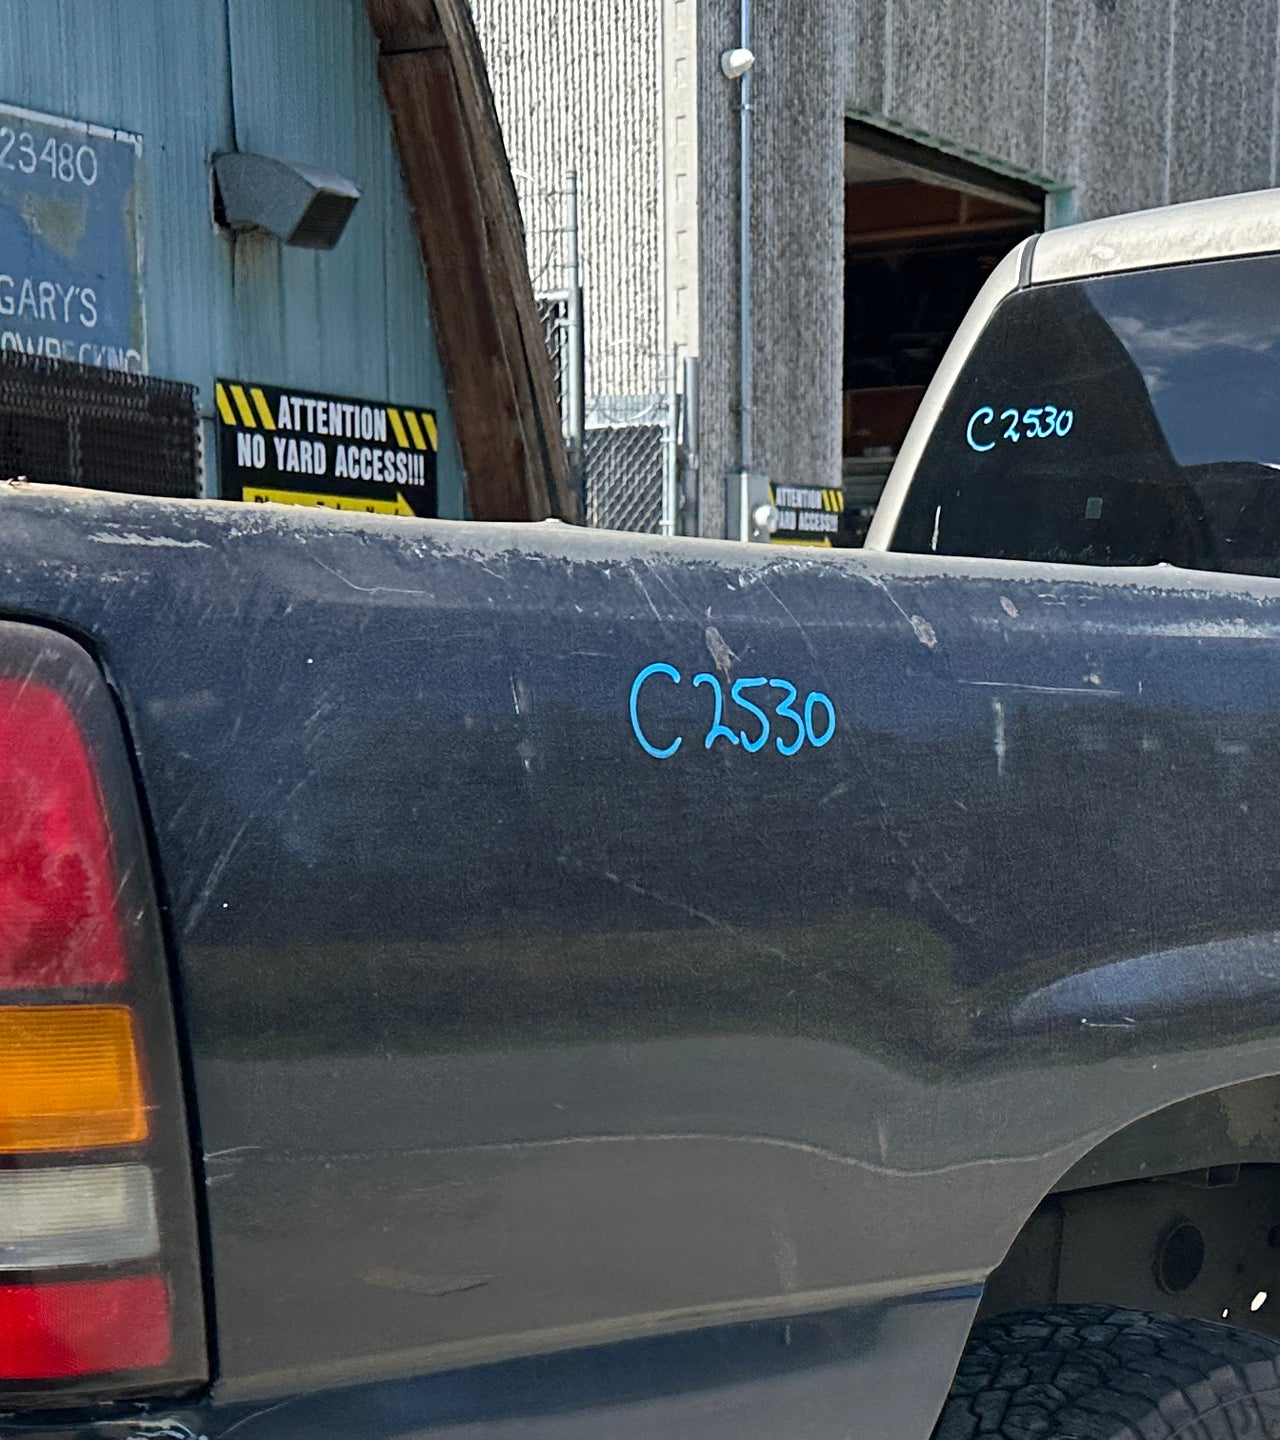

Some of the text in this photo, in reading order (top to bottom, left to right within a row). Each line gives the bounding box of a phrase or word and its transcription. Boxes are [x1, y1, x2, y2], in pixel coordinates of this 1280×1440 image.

[277, 395, 387, 443] ATTENTION
[966, 404, 1074, 452] C2530
[236, 432, 425, 486] NO YARD ACCESS!!!
[628, 661, 837, 759] C2530
